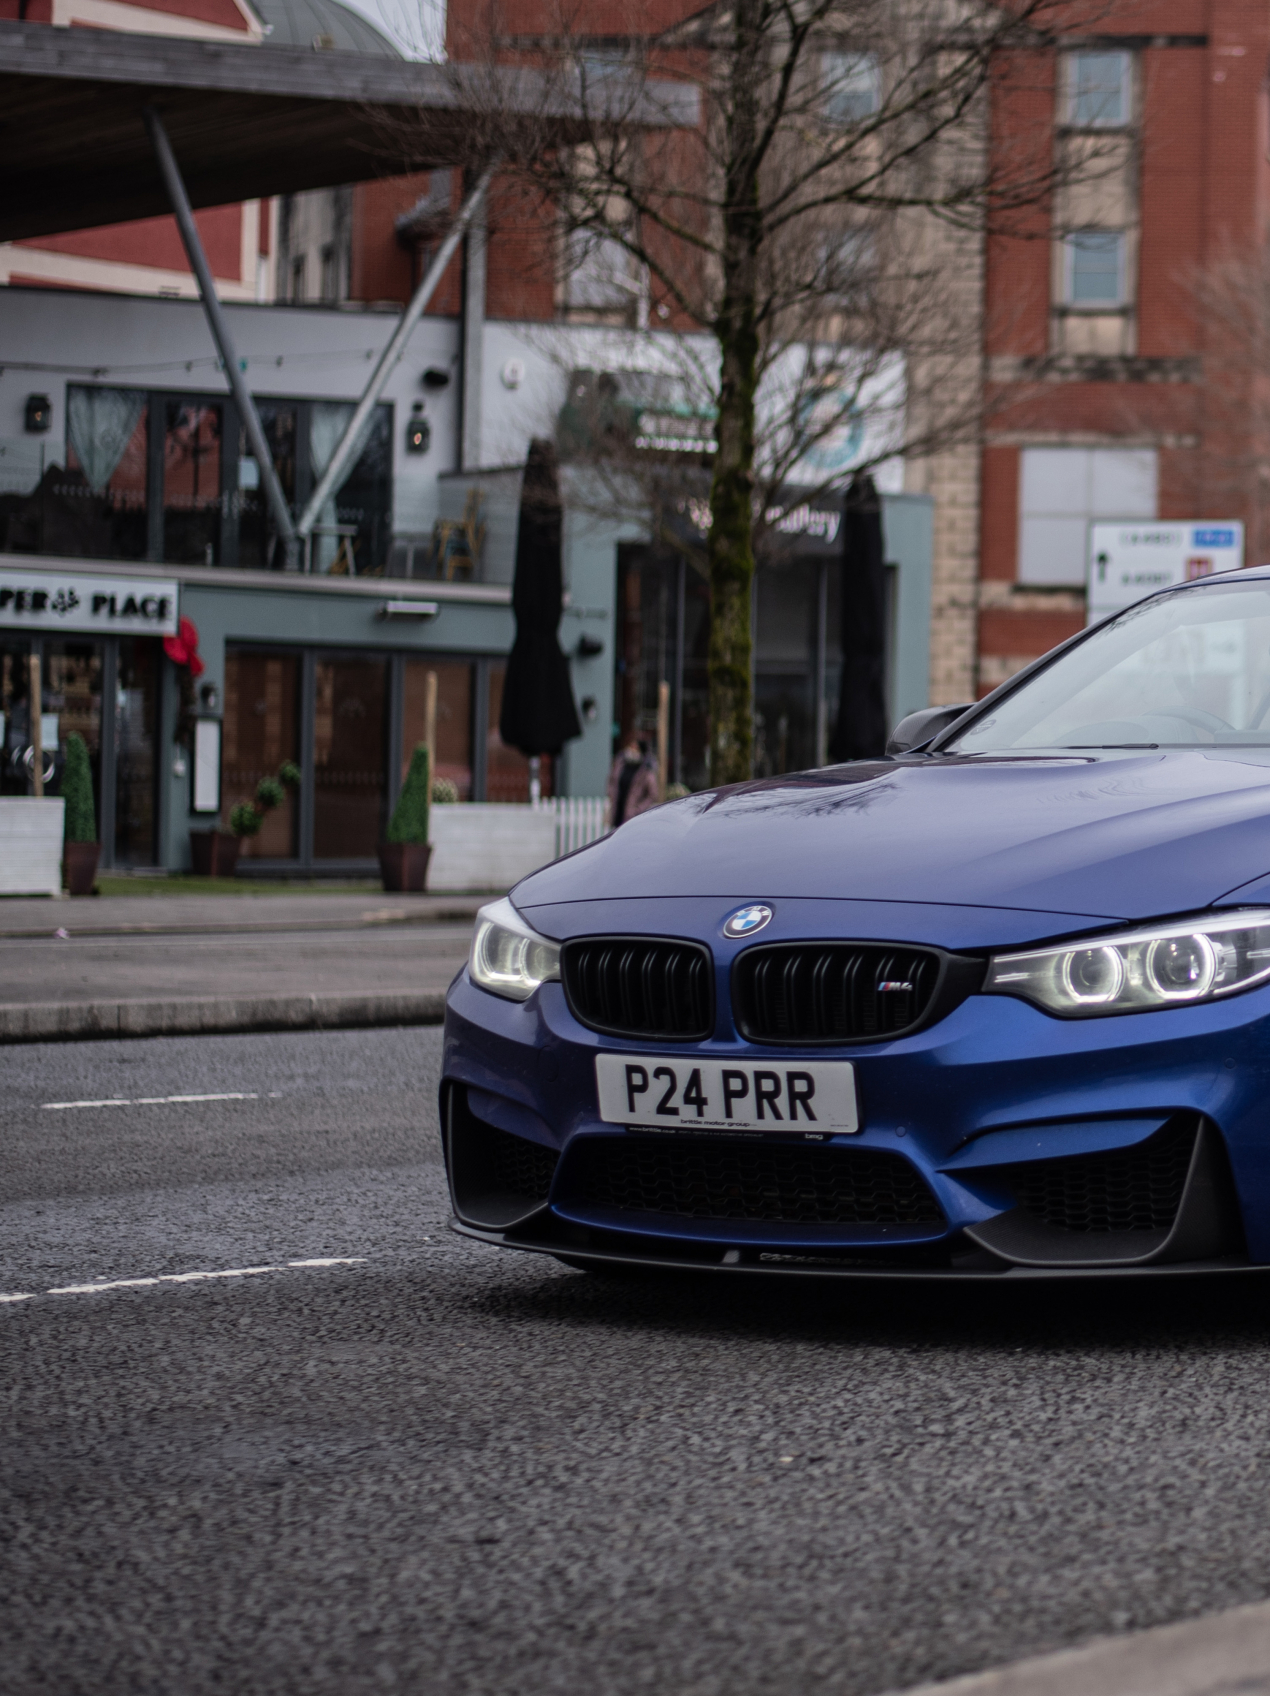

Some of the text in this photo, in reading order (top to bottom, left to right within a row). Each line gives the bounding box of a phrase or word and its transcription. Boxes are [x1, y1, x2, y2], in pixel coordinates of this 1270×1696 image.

[92, 592, 172, 619] PLACE
[625, 1064, 818, 1121] P24 PRR
